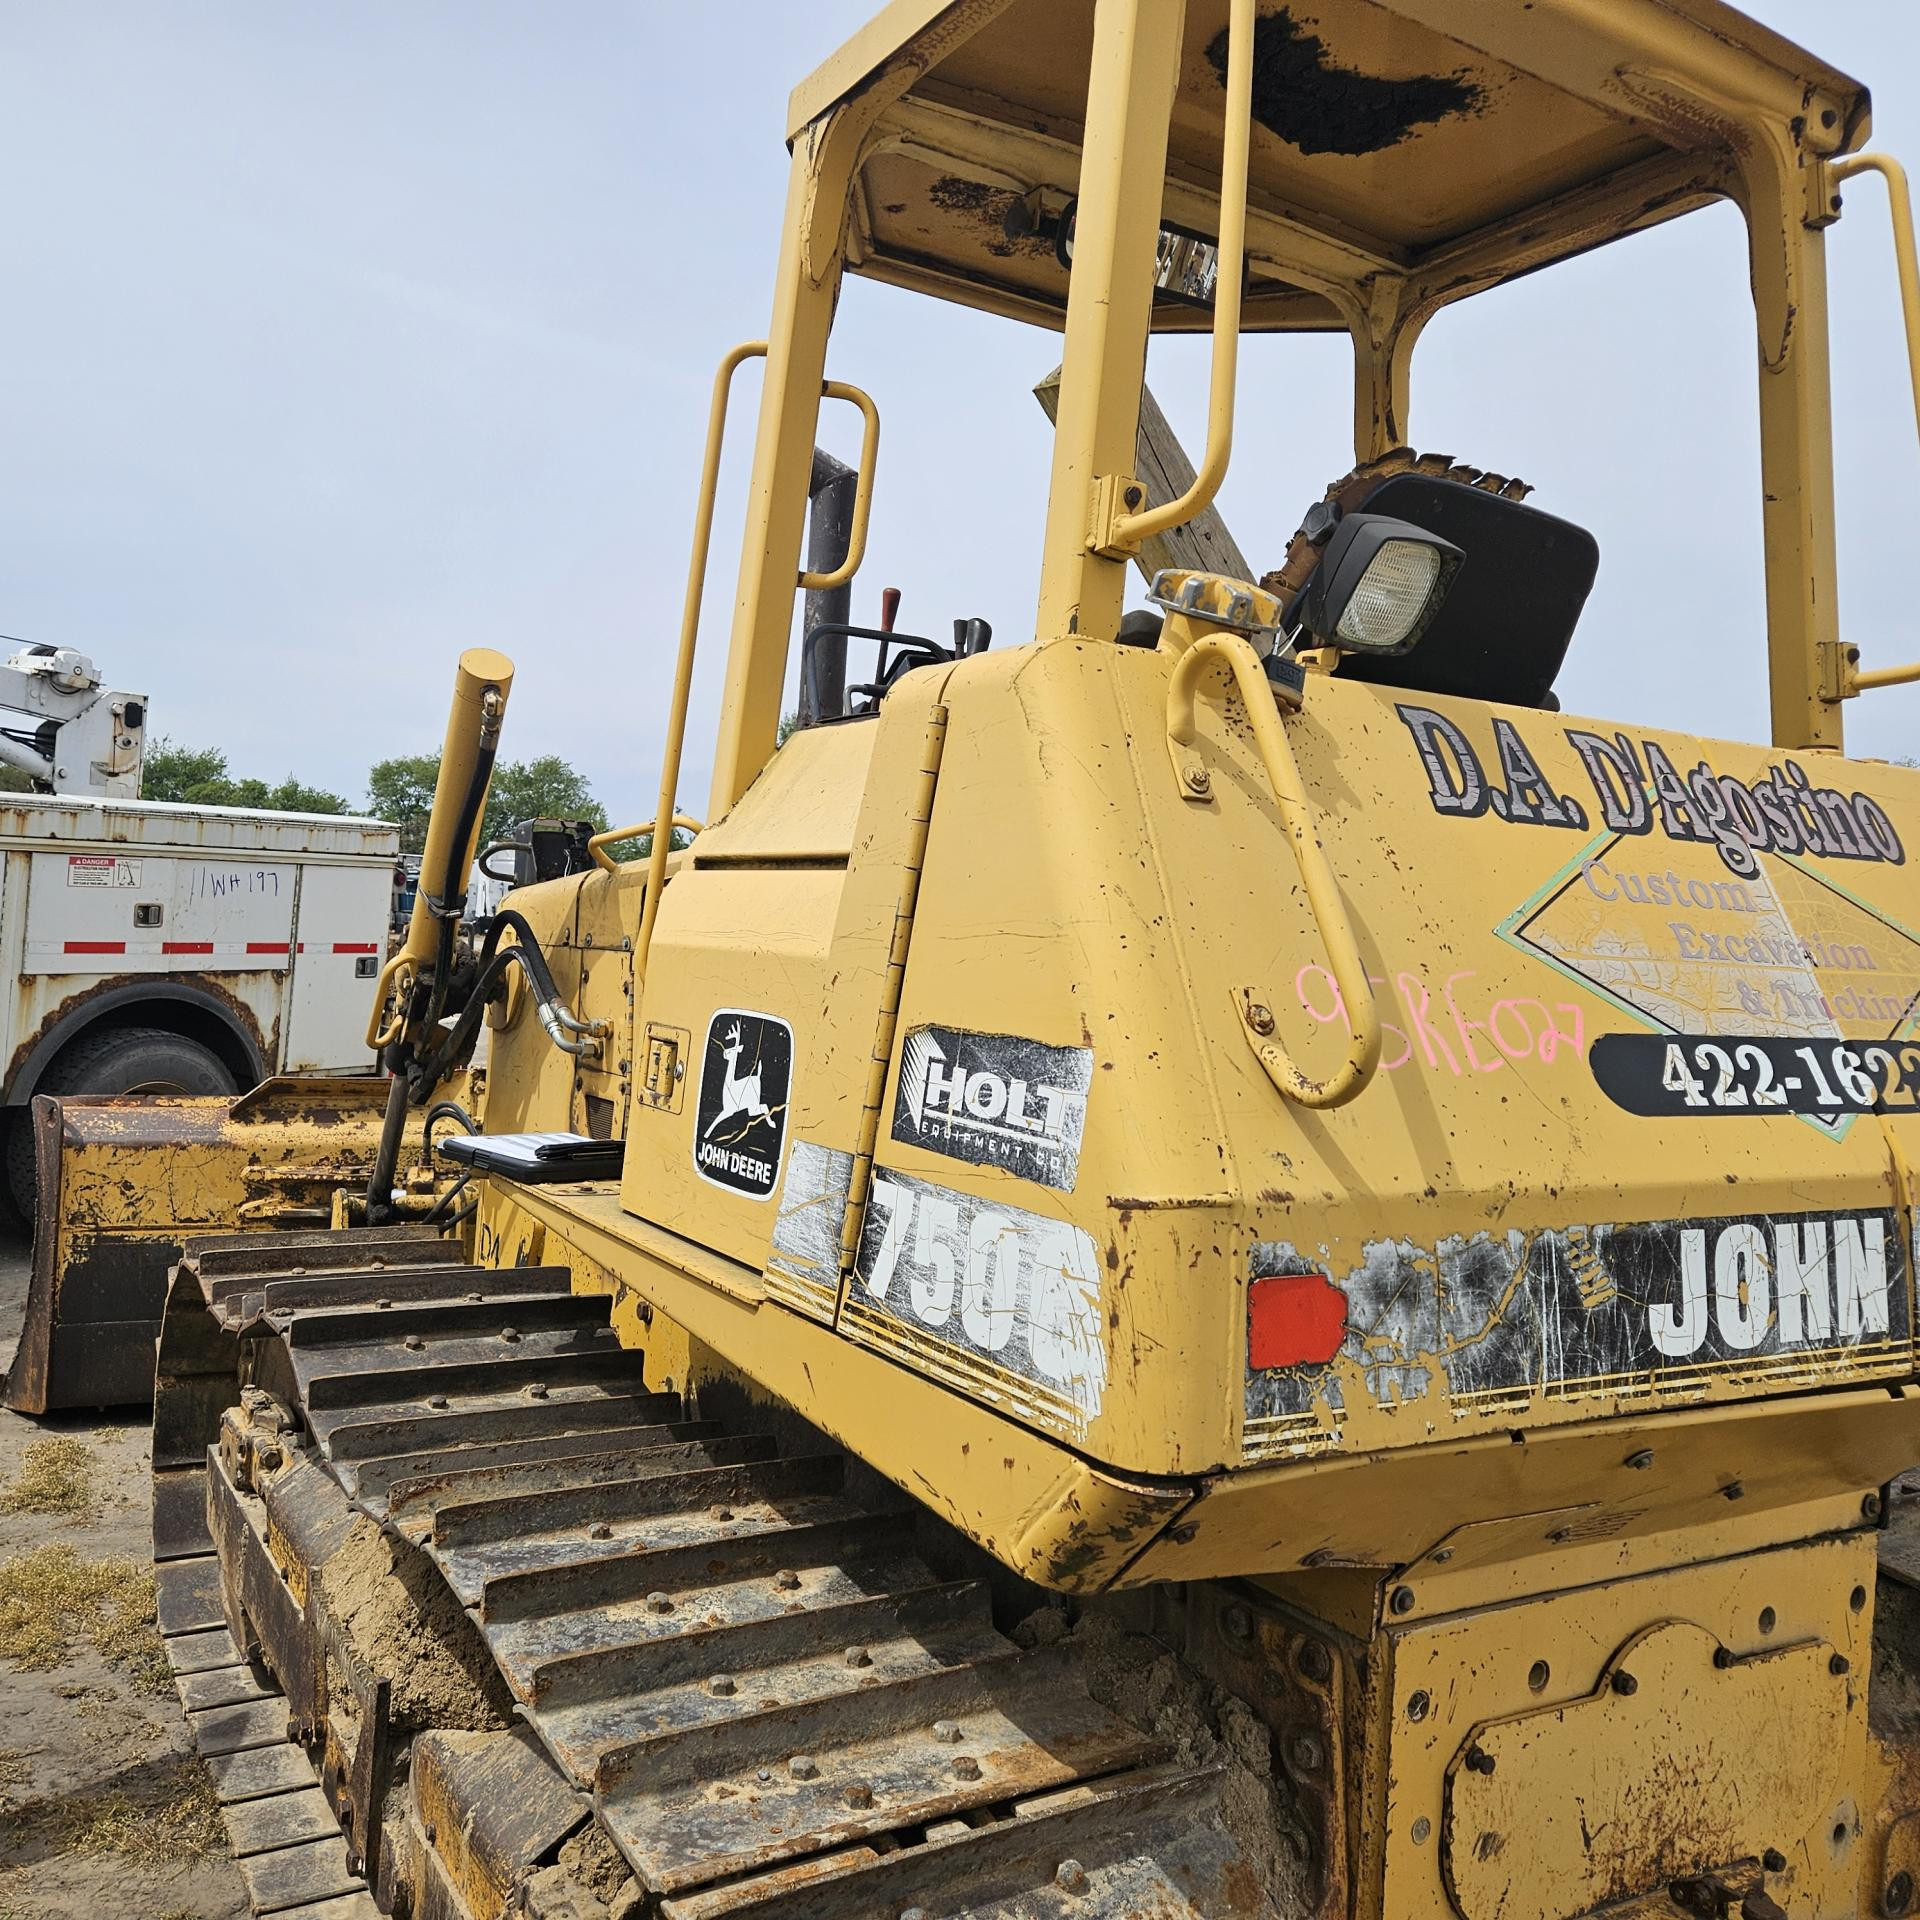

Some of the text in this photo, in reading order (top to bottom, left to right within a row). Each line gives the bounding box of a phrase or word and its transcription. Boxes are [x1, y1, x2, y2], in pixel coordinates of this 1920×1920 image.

[1394, 703, 1906, 880] D.A. D'Agostino
[81, 858, 109, 866] DANGER
[1581, 859, 1757, 913] Custom
[1668, 922, 1877, 970] Excavation
[1736, 979, 1770, 1016] &
[925, 1061, 1087, 1138] HOLT
[698, 1142, 772, 1185] JOHN DEERE
[921, 1121, 1022, 1159] EQUIPMENT
[1648, 1217, 1889, 1357] JOHN
